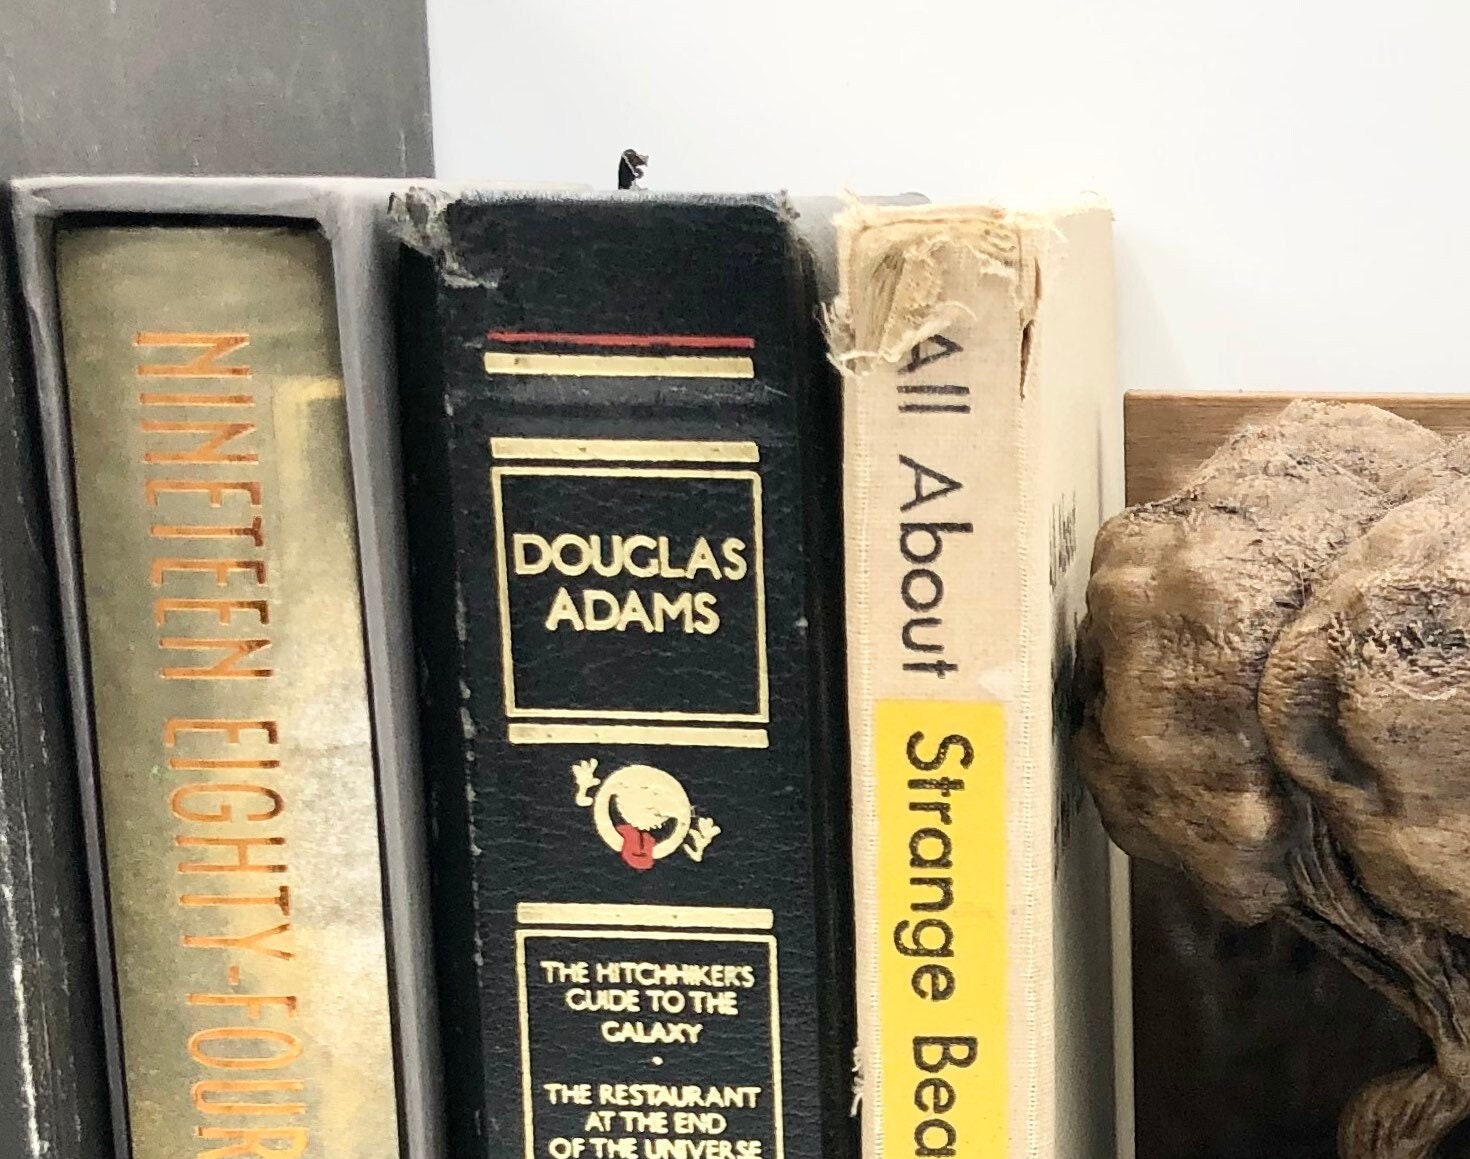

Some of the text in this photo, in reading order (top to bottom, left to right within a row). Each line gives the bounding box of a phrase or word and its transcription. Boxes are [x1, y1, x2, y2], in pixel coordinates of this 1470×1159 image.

[134, 331, 272, 680] NINETEEN
[896, 334, 974, 680] All About
[513, 532, 748, 581] DOUGLAS
[545, 587, 721, 635] ADAMS
[894, 731, 975, 1002] Strange
[540, 961, 589, 983] THE
[565, 988, 738, 1015] GUIDE TO THE
[601, 1021, 703, 1043] GALAXY
[543, 1083, 761, 1108] THE RESTAURANT
[585, 1111, 727, 1134] AT THE END
[549, 1138, 585, 1159] OF
[589, 1138, 638, 1159] THE
